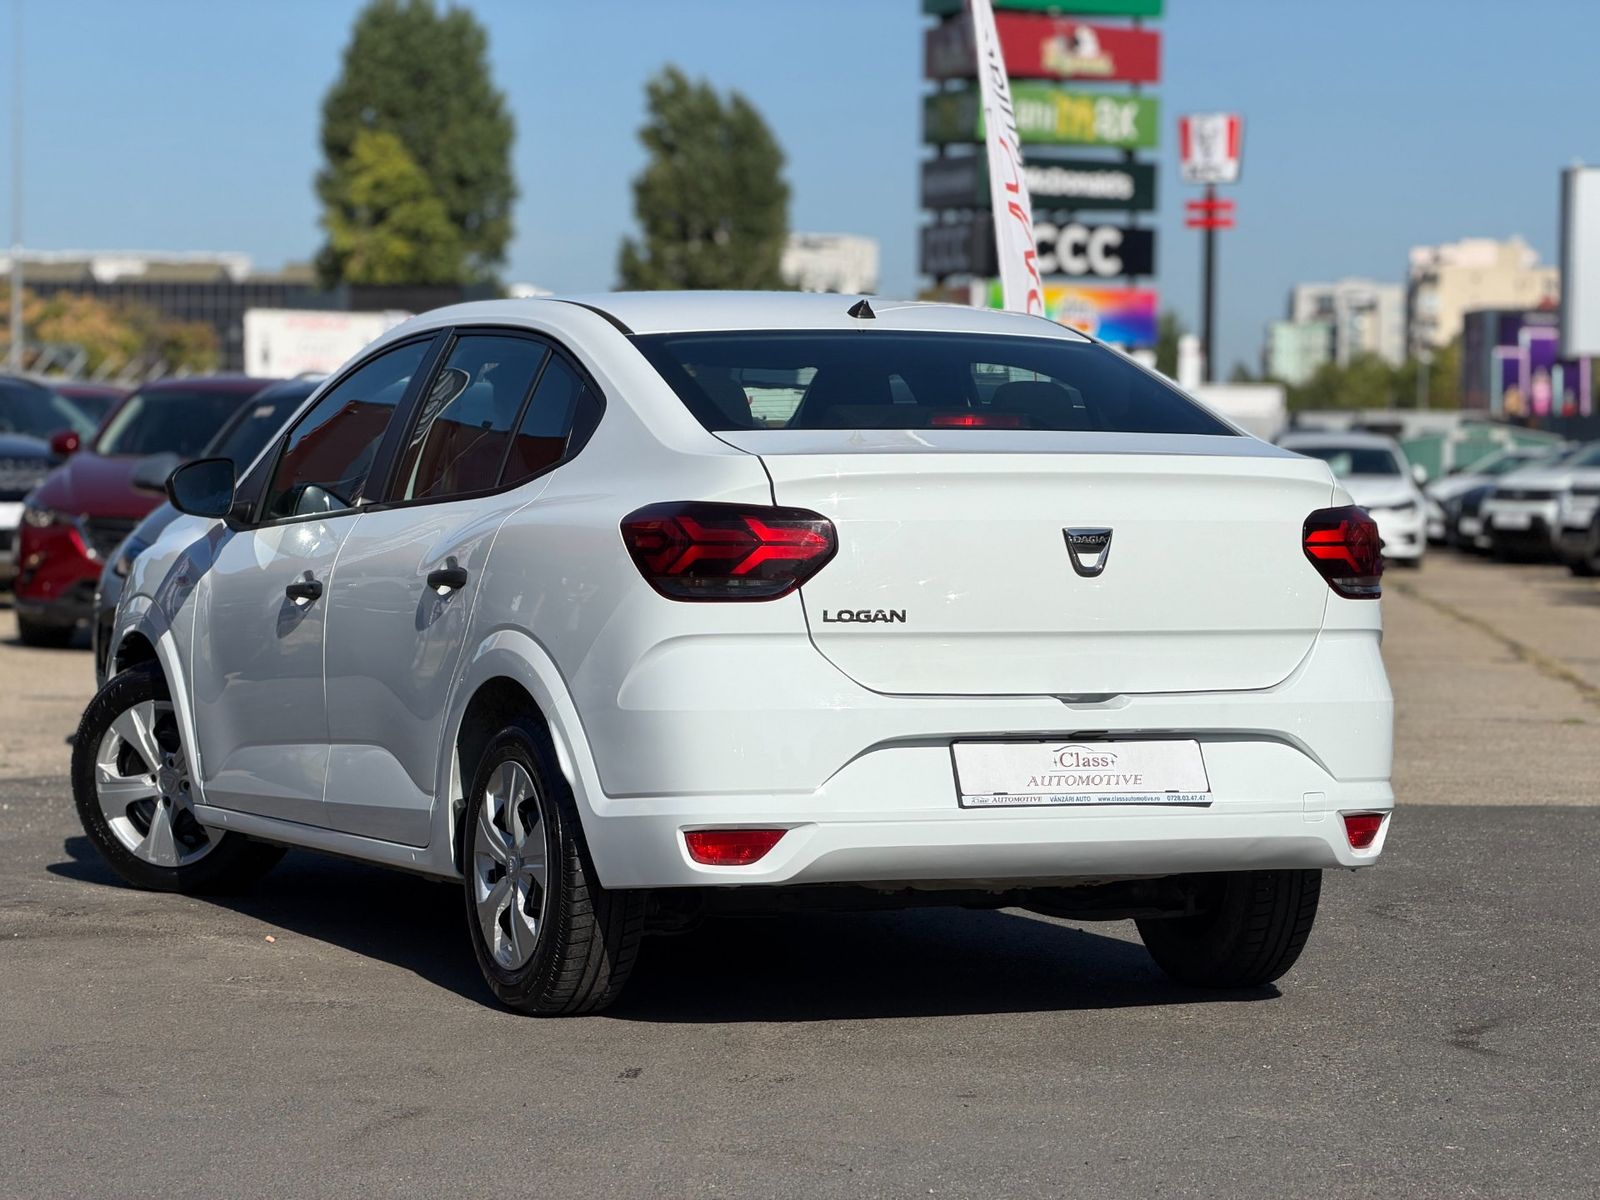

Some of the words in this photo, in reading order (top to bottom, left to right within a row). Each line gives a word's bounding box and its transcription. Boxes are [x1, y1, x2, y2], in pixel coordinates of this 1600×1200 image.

[822, 608, 907, 623] LOGAN
[1059, 752, 1109, 768] Class
[1026, 774, 1143, 787] AUTOMOTIVE
[992, 796, 1042, 804] AUTOMOTIVE
[1075, 795, 1092, 803] AUTO
[1097, 794, 1161, 802] www.classautomotive.ro
